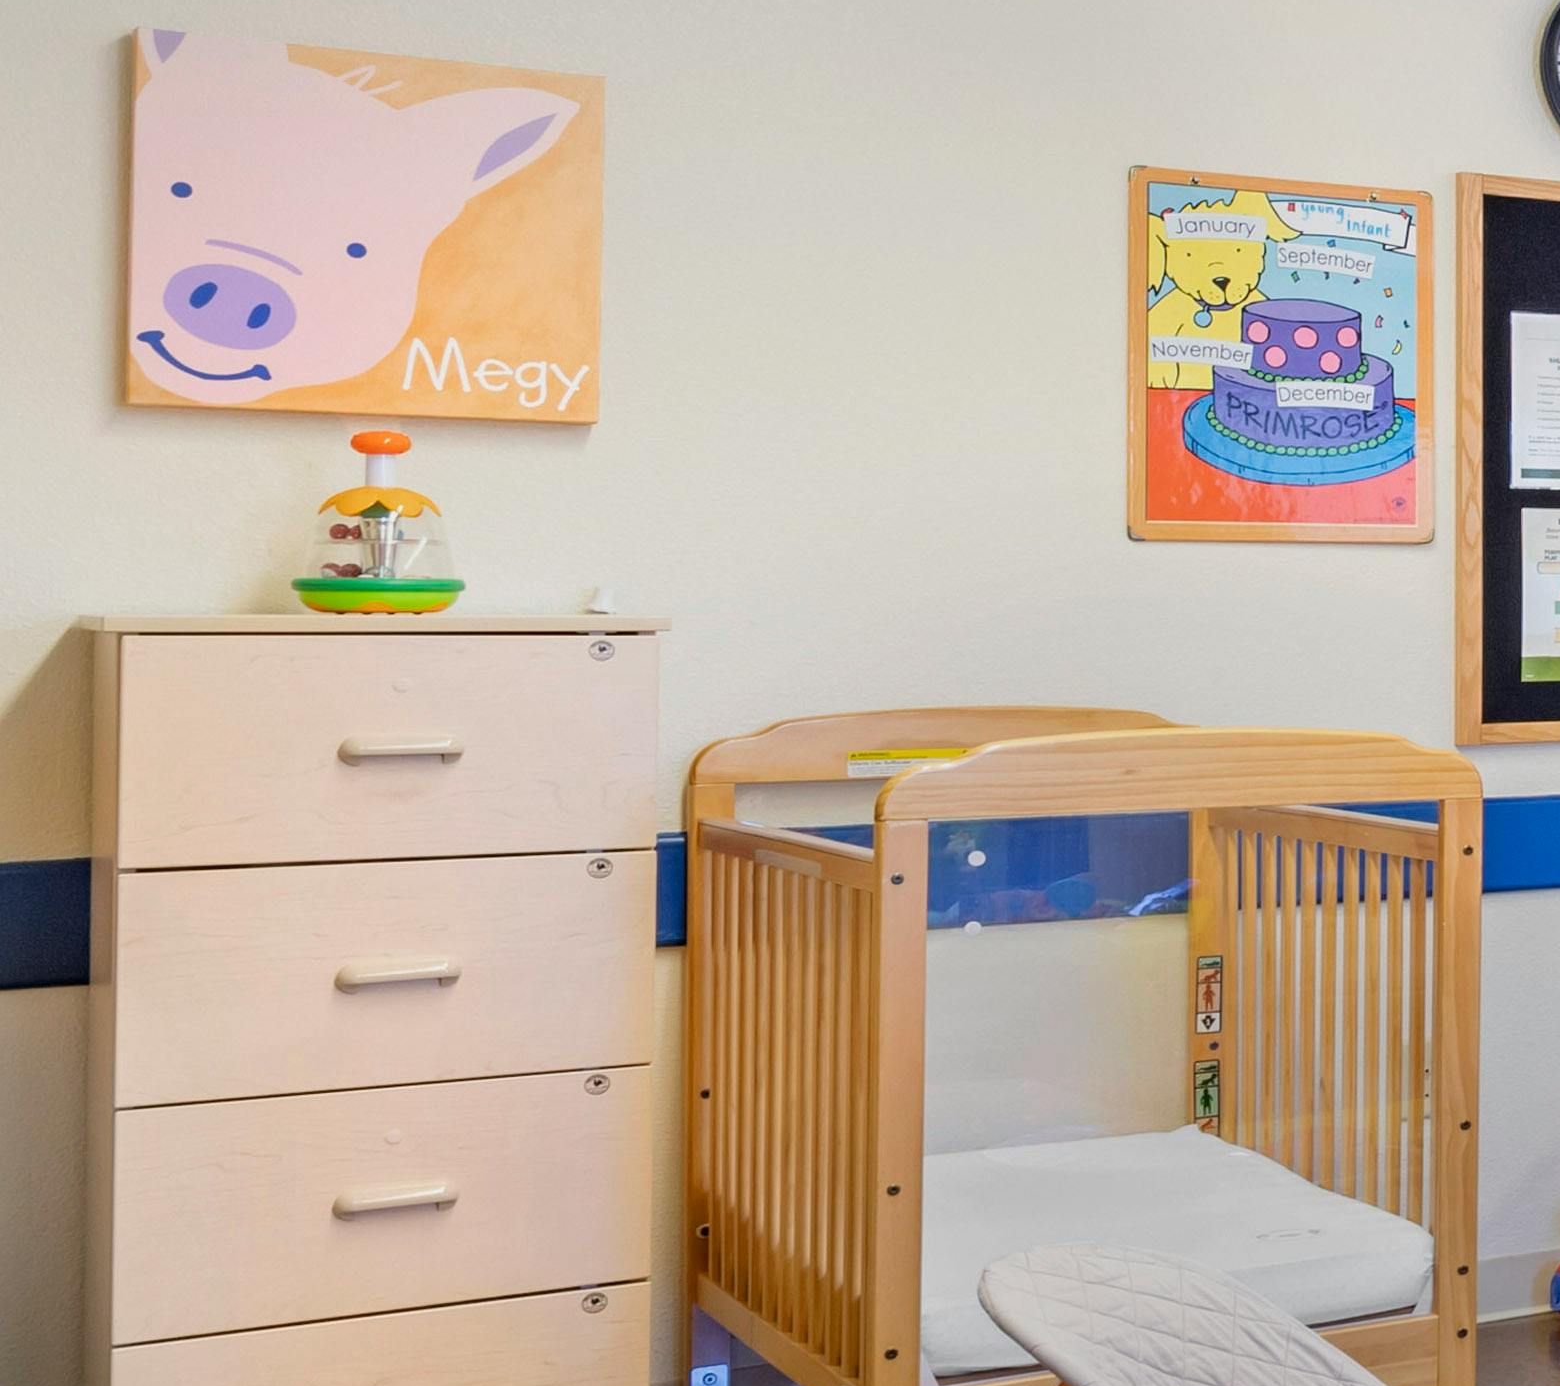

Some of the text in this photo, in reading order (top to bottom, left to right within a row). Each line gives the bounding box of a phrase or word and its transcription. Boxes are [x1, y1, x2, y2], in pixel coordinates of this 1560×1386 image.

[1300, 202, 1345, 224] young
[1174, 216, 1256, 237] January
[1346, 218, 1393, 238] infant
[1277, 247, 1373, 274] September
[1151, 342, 1252, 363] November
[402, 337, 590, 412] Megy
[1277, 385, 1373, 405] December
[1225, 391, 1380, 440] PRIMROSE
